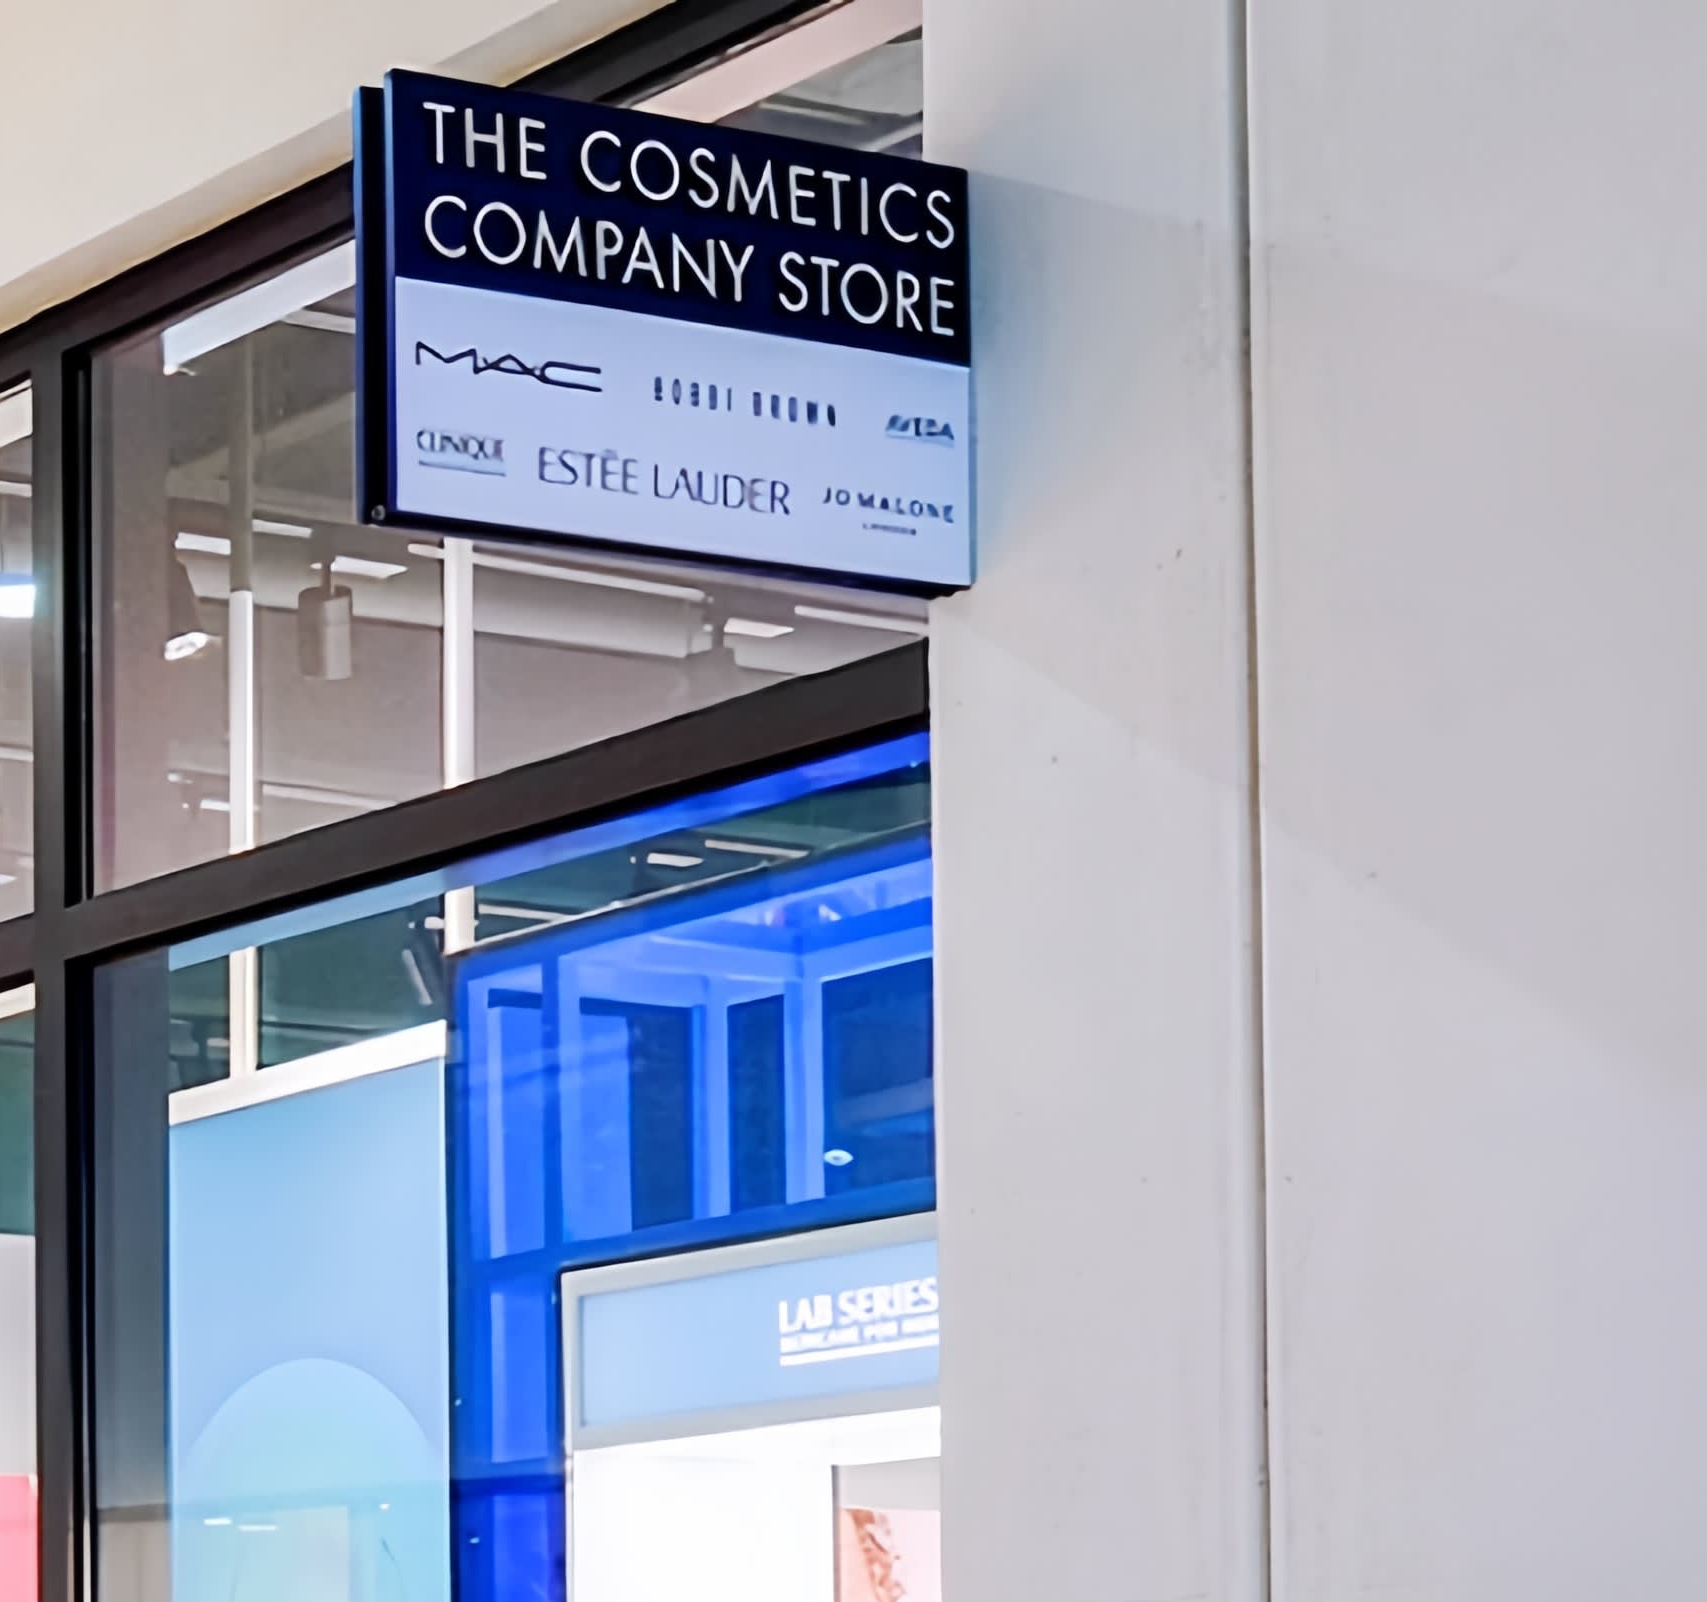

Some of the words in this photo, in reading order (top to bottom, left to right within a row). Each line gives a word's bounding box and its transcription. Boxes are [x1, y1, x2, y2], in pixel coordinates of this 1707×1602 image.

[423, 101, 547, 180] THE
[580, 130, 956, 250] COSMETICS
[424, 195, 755, 302] COMPANY
[778, 251, 956, 337] STORE
[654, 463, 791, 516] LAUDER
[822, 487, 851, 507] JO
[857, 492, 955, 524] MALONE
[779, 1293, 833, 1334] LAB
[838, 1275, 939, 1326] SERIES
